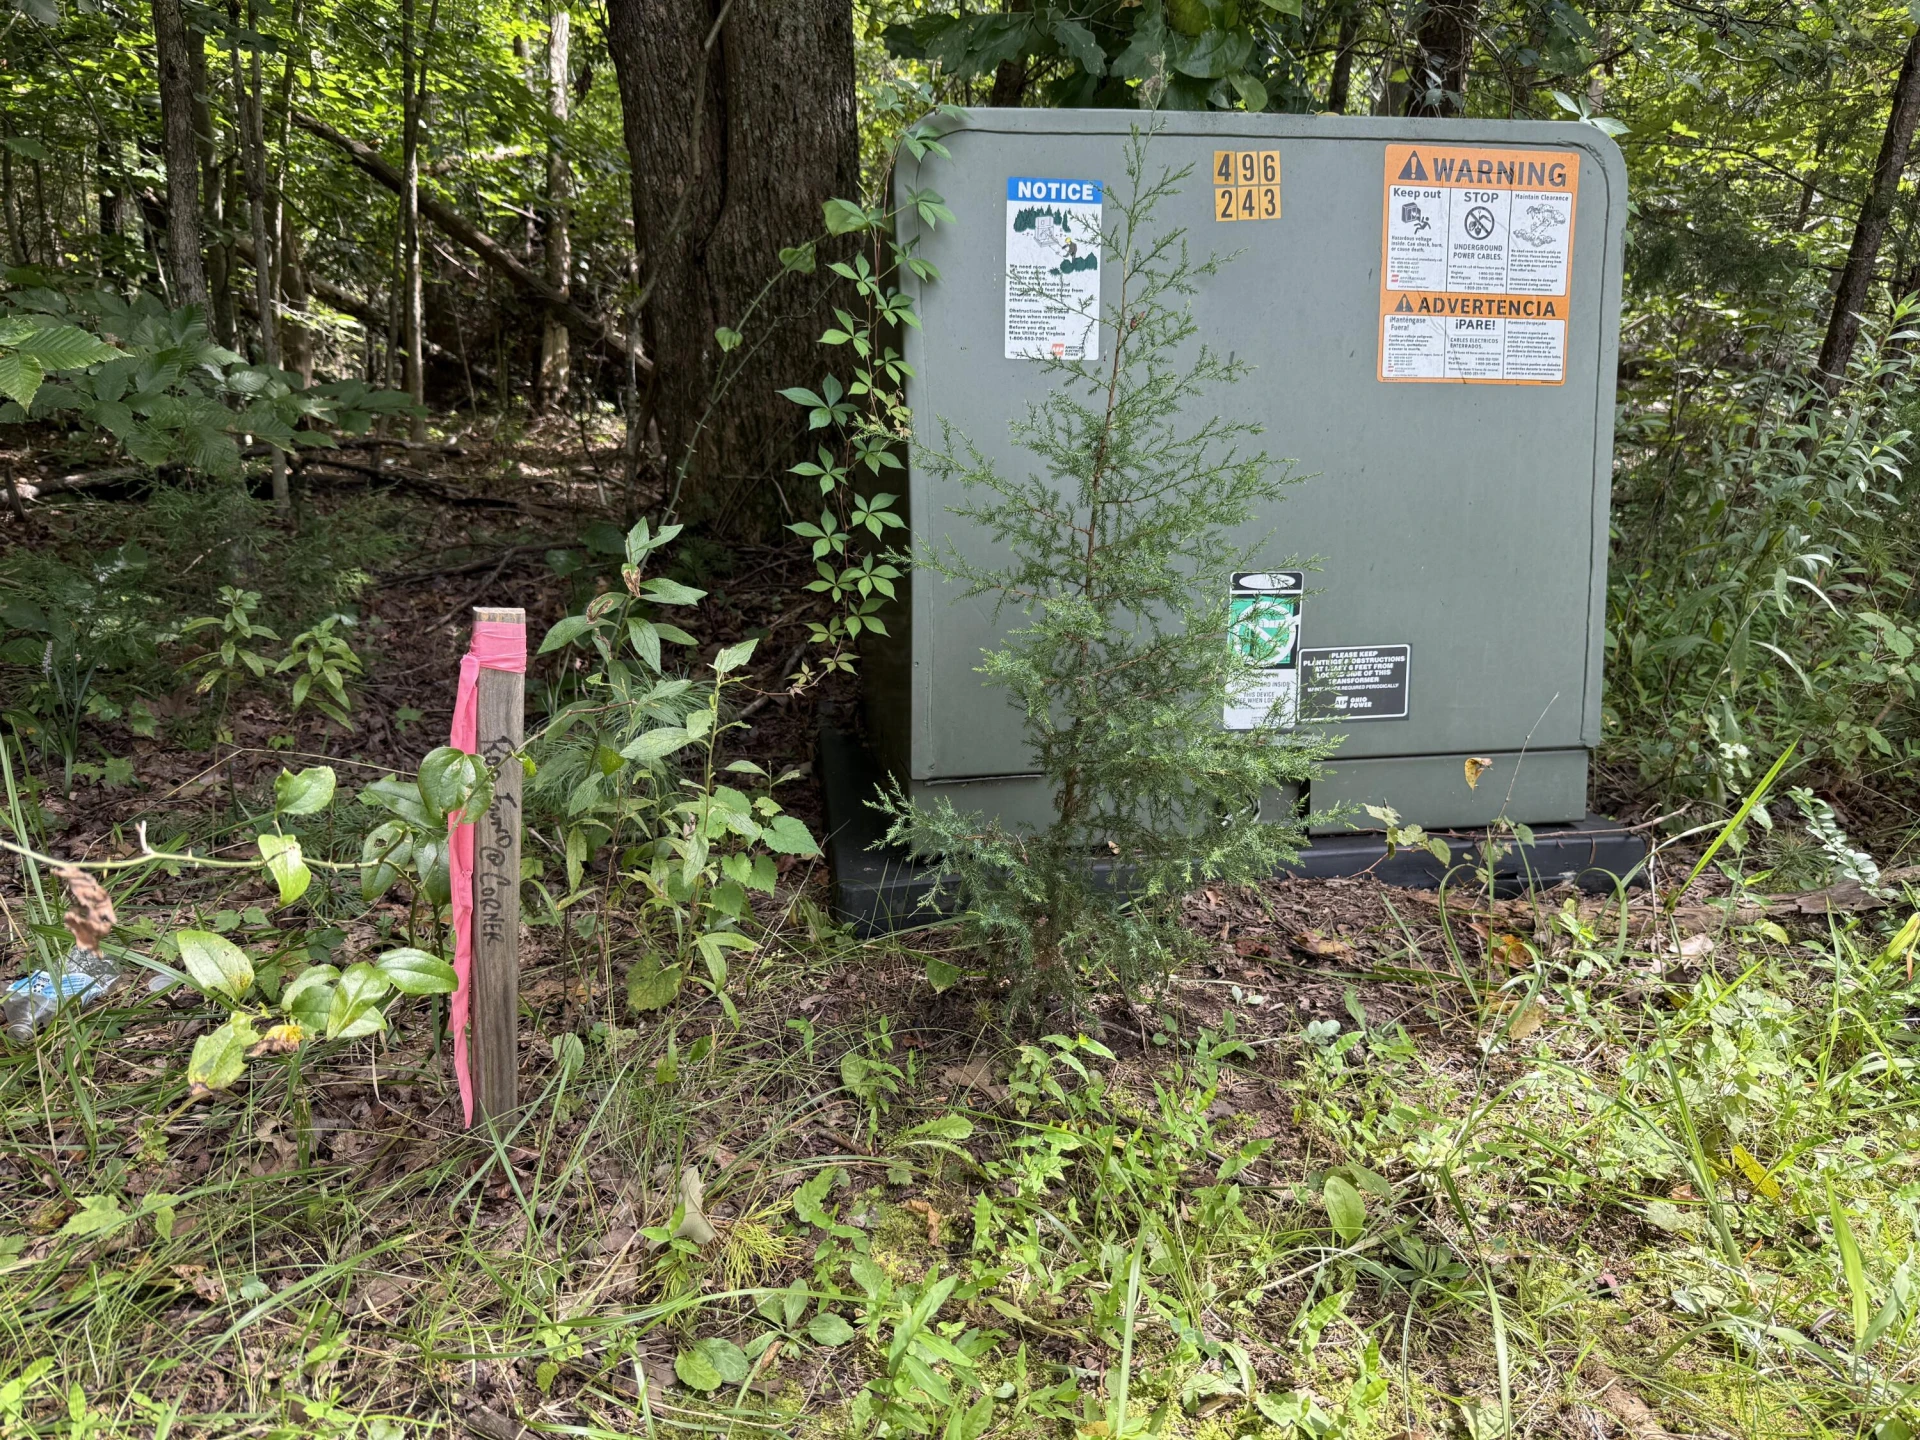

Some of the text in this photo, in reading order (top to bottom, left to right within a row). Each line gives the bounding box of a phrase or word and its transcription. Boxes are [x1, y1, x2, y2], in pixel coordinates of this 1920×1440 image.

[1218, 154, 1276, 182] 496
[1432, 157, 1566, 187] WARNING
[1018, 182, 1094, 200] NOTICE
[1393, 187, 1441, 200] Keep out
[1464, 191, 1499, 203] STOP
[1221, 188, 1276, 218] 243
[1418, 296, 1556, 317] ADVERTENCIA
[1455, 319, 1496, 330] ¡PARE!
[1351, 656, 1405, 664] OBSTRUCTIONS
[480, 846, 506, 867] @
[480, 872, 512, 947] CORNER
